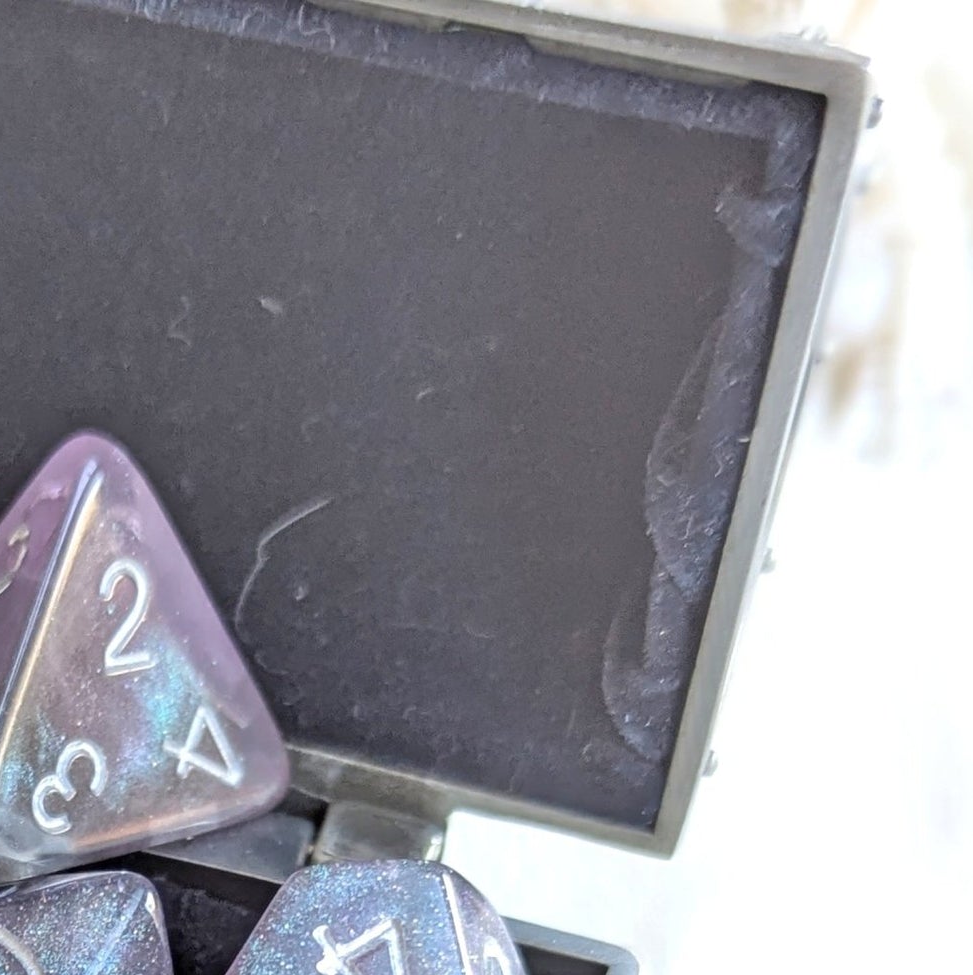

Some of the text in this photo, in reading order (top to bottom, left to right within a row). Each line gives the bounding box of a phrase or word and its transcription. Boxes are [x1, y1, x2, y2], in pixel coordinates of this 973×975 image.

[98, 557, 155, 677] 2
[30, 738, 108, 834] 3
[162, 705, 244, 788] 4
